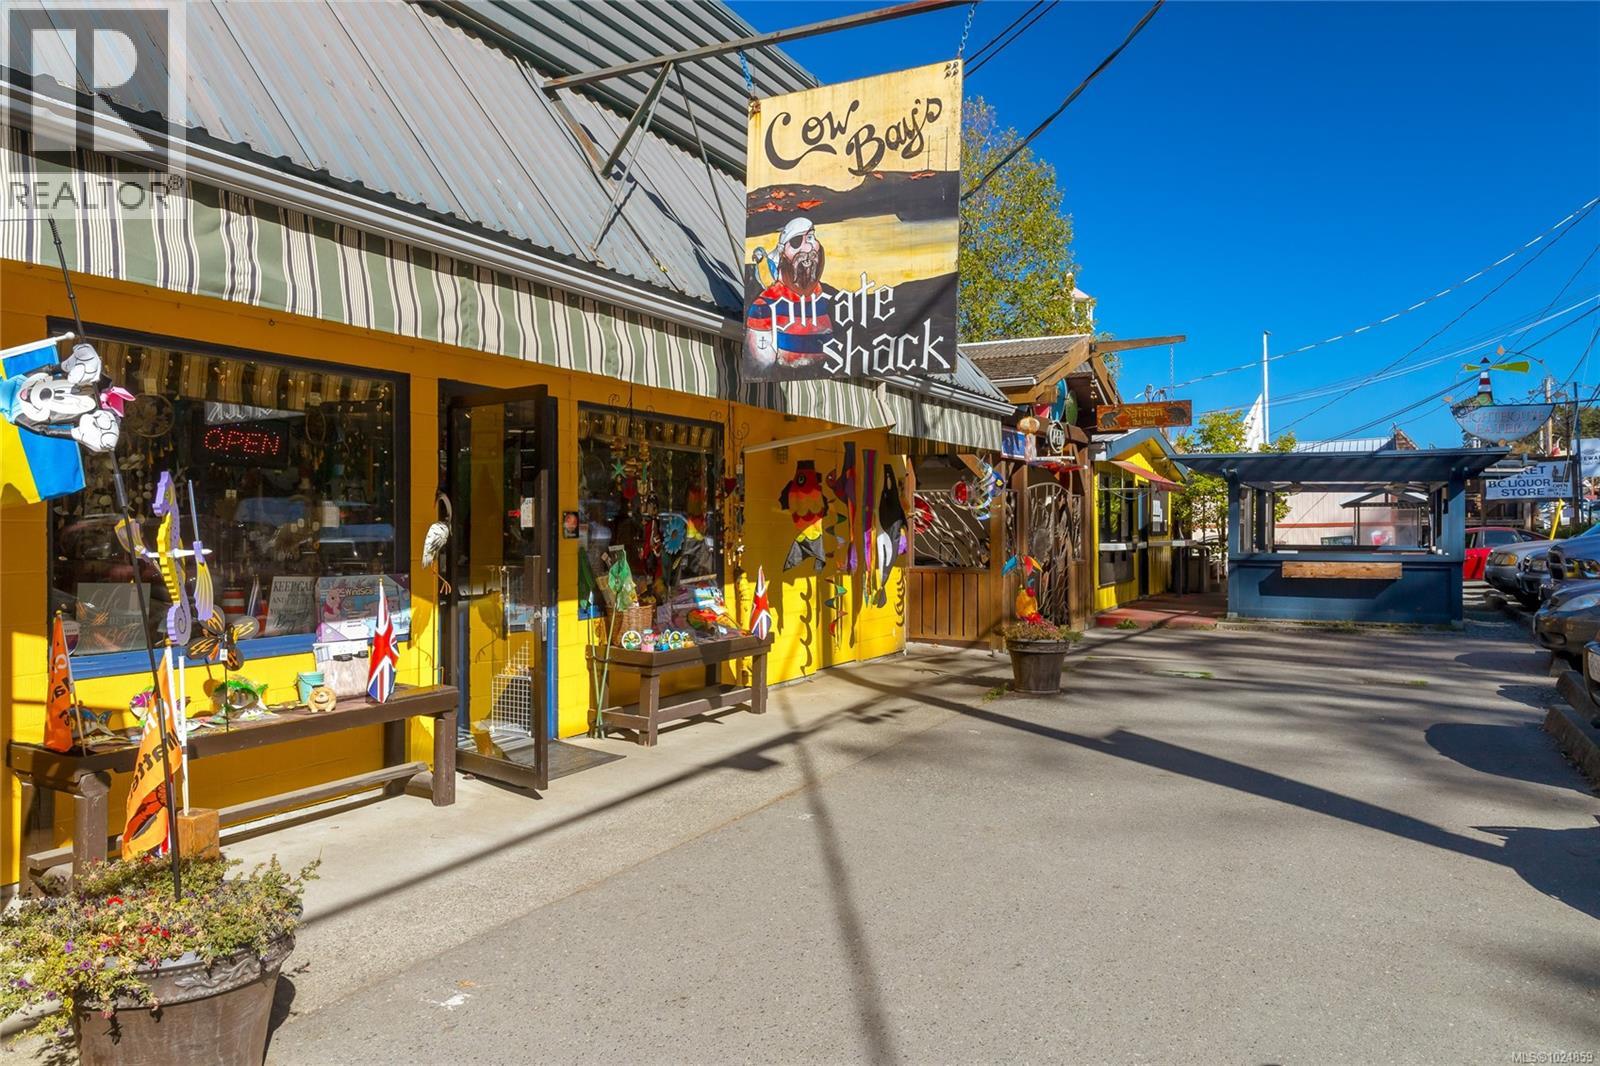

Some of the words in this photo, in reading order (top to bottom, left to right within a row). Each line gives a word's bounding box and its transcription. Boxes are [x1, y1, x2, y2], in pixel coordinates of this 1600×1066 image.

[765, 100, 859, 170] Cow
[846, 97, 942, 176] Bay's
[769, 272, 895, 359] pirate
[823, 318, 950, 375] shack
[204, 429, 279, 455] OPEN
[1501, 487, 1545, 497] STORE
[1508, 479, 1550, 488] LIQUOR
[273, 581, 297, 592] KEEP
